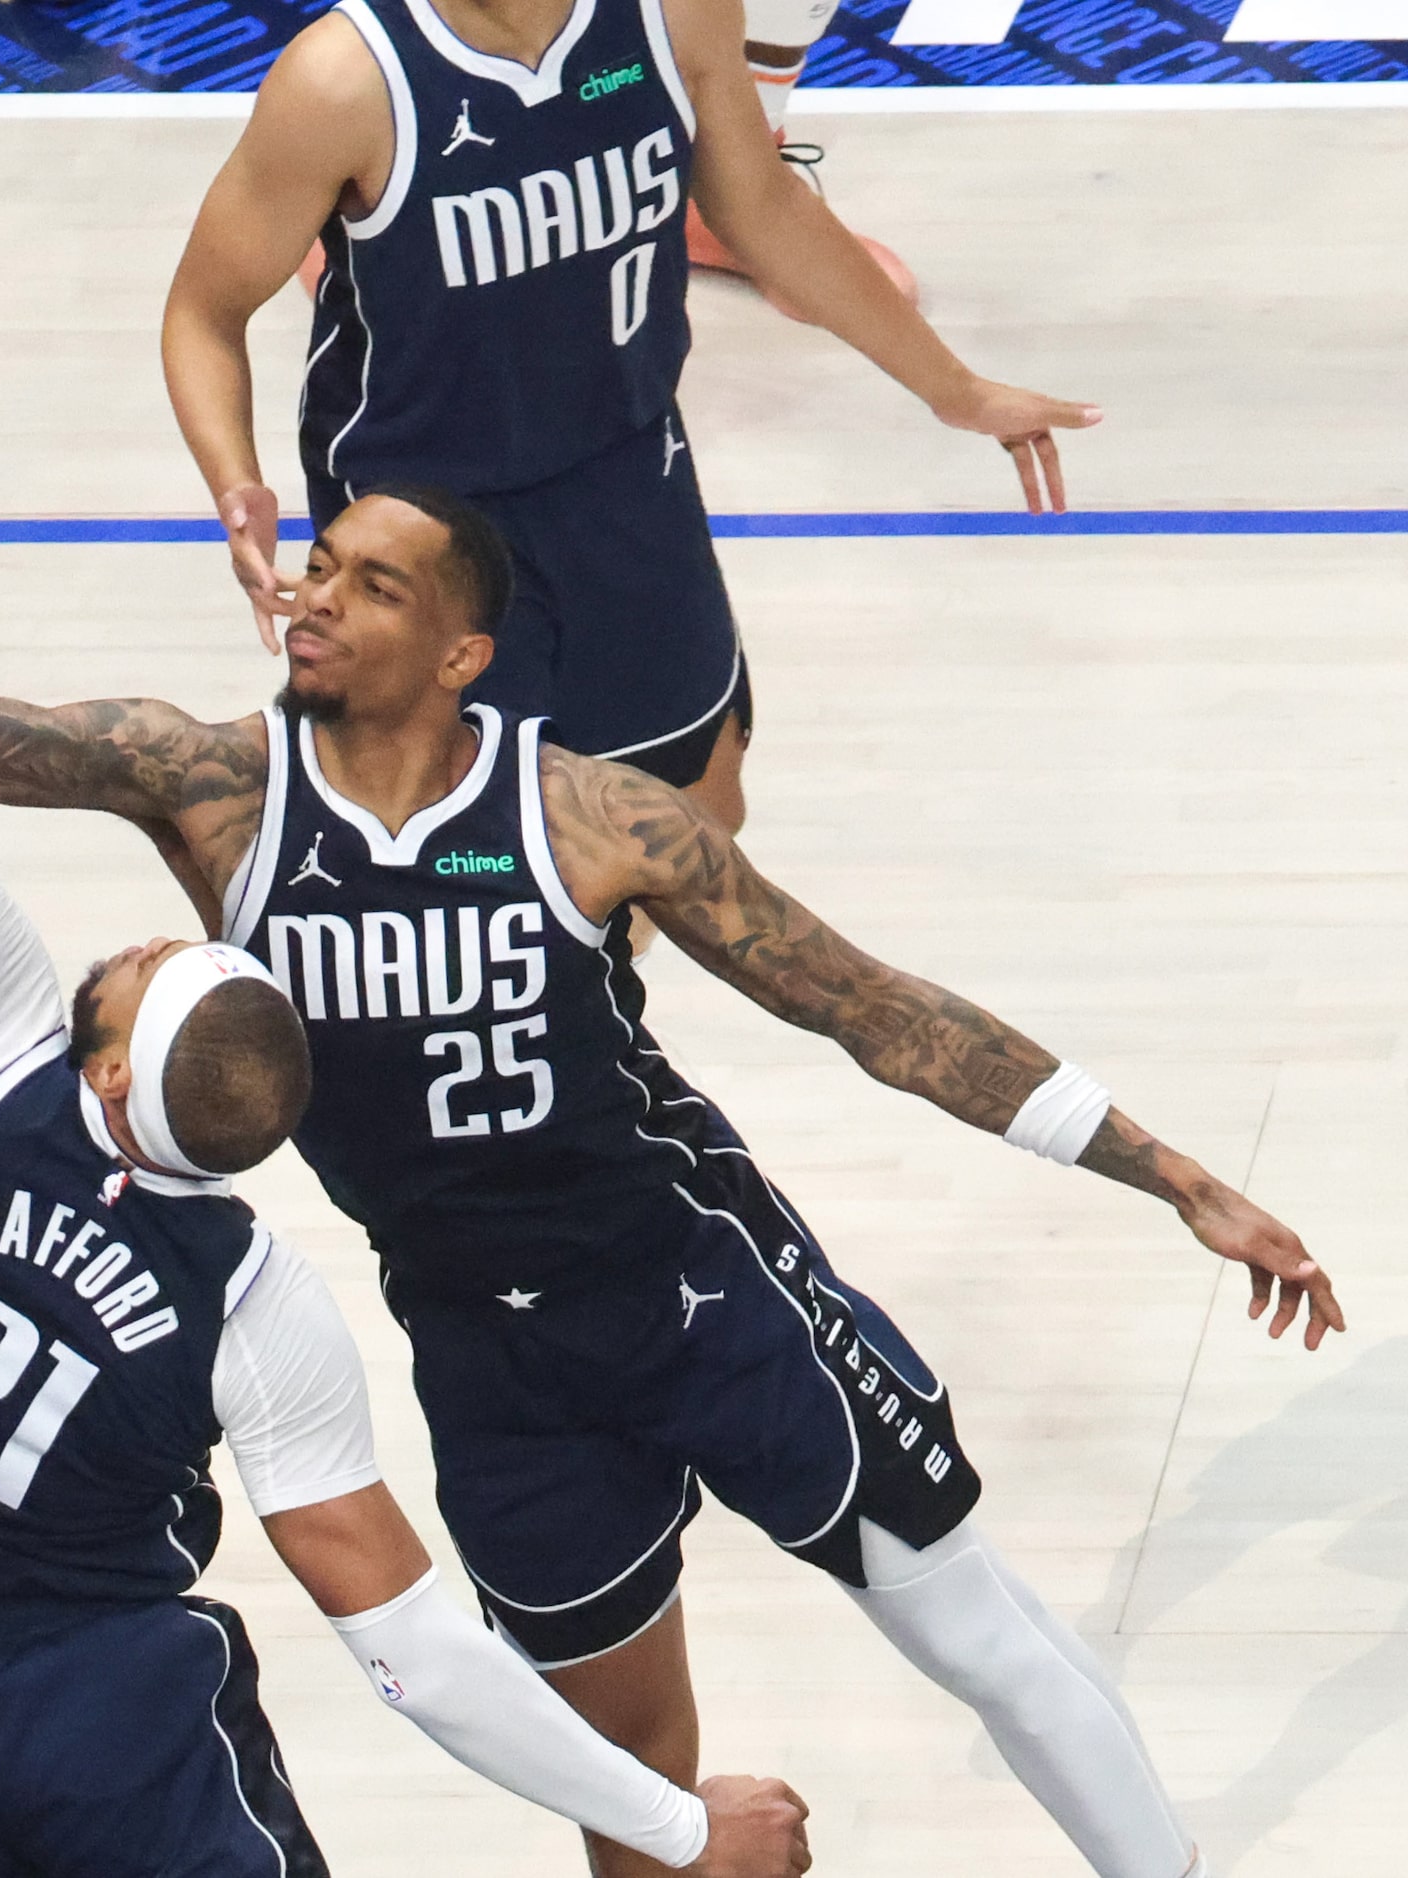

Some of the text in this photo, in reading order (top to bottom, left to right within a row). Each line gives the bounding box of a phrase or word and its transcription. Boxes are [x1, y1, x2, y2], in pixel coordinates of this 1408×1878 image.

[57, 0, 269, 75] RAD
[579, 62, 646, 102] chime
[1015, 0, 1186, 68] INCE
[432, 127, 680, 288] MAVS
[610, 242, 657, 347] 0
[434, 850, 515, 875] chime
[267, 902, 547, 1020] MAVS
[423, 1014, 555, 1139] 25
[775, 1243, 953, 1485] MAVERIS
